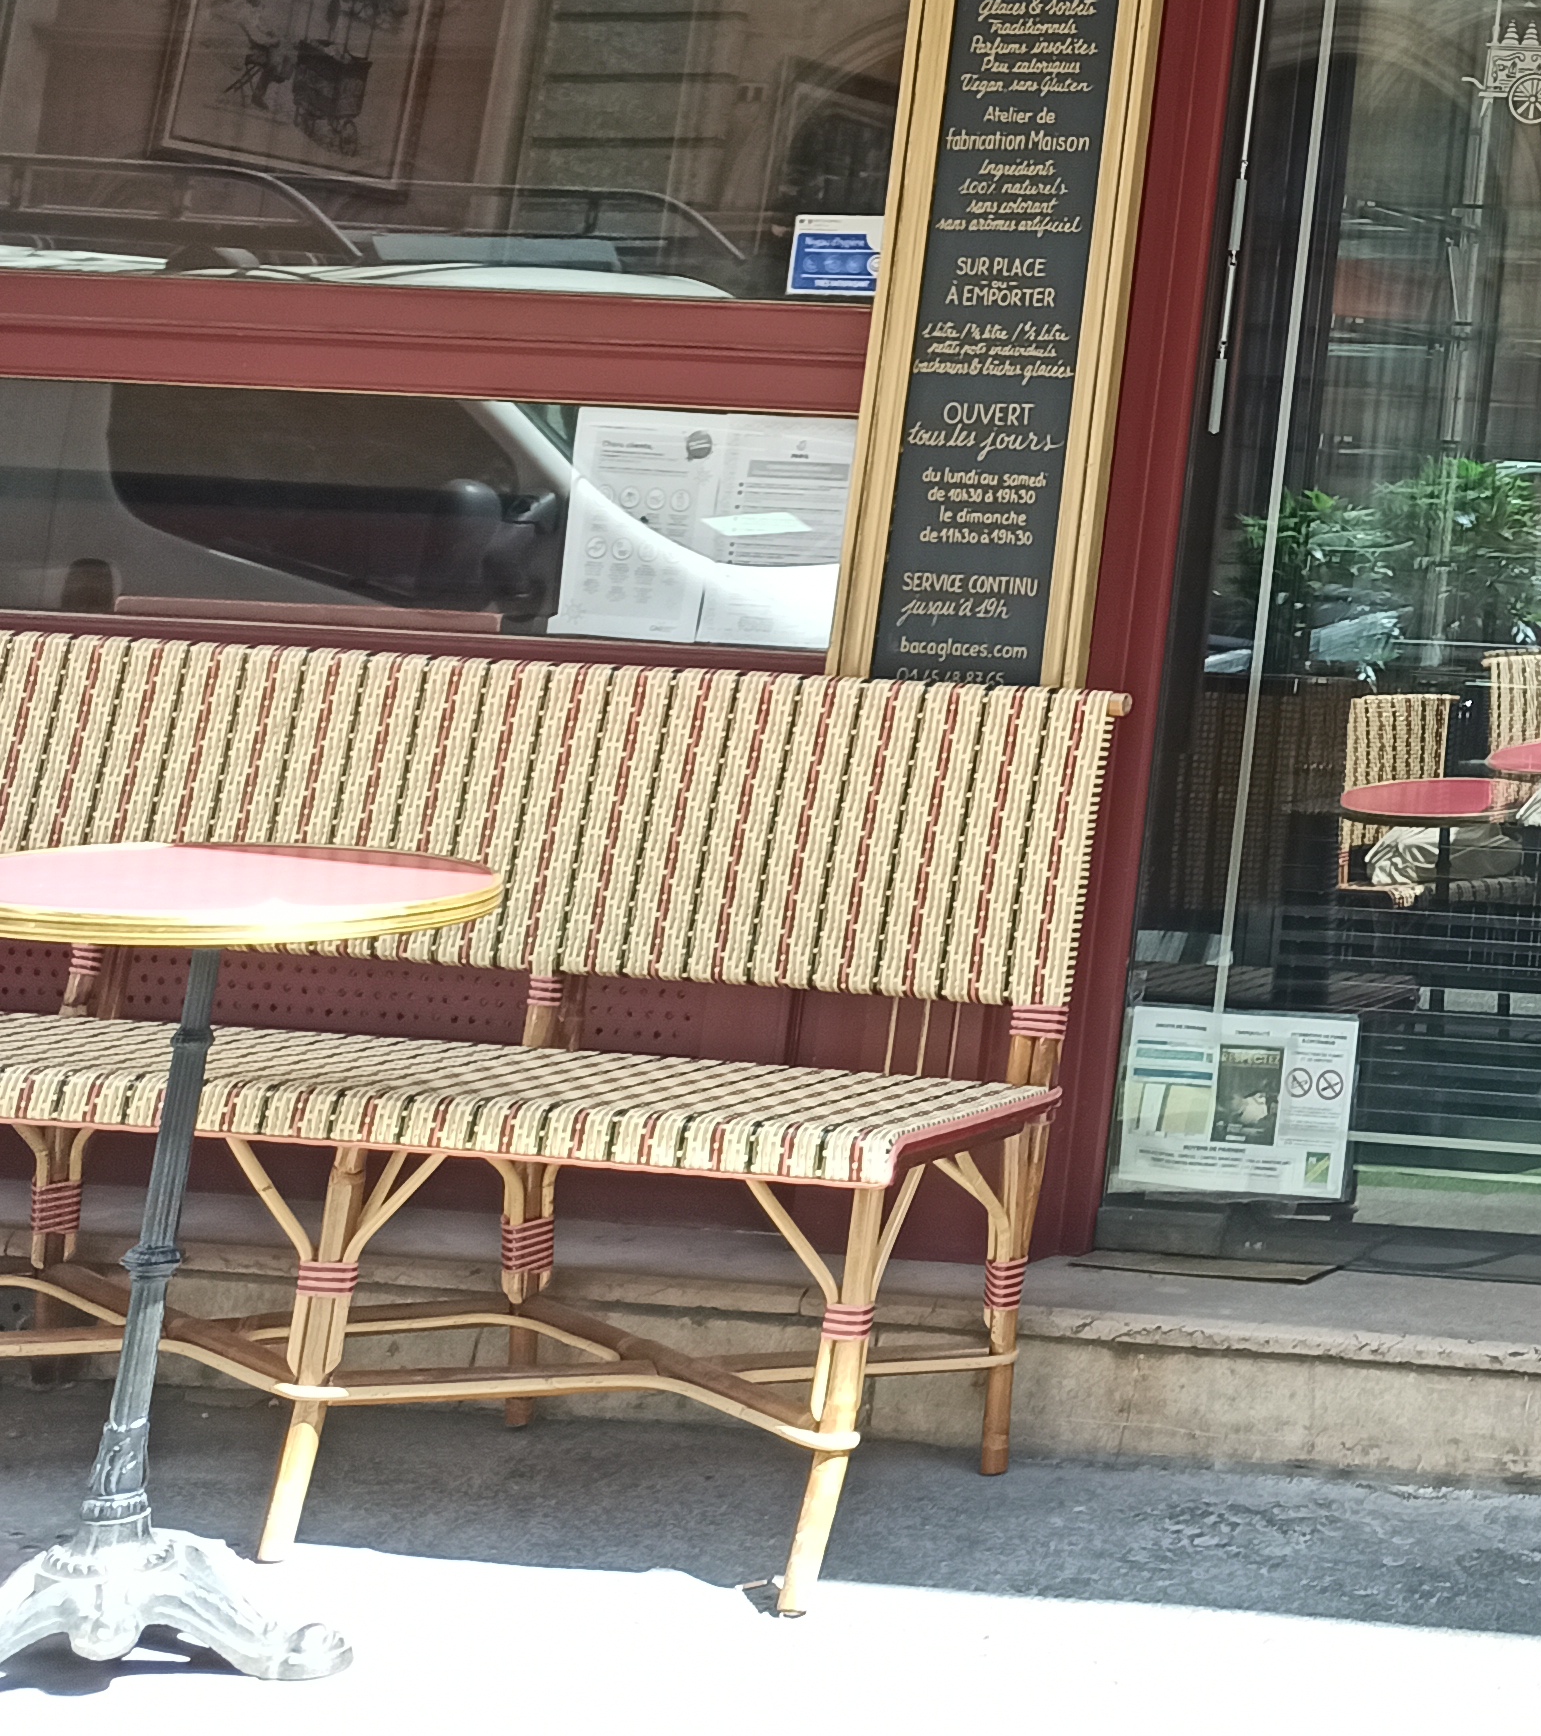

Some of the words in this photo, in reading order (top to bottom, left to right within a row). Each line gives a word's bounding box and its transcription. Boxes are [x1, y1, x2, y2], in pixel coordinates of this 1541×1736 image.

[989, 18, 1078, 35] Traditionnels
[970, 35, 1028, 57] Parfums
[1030, 37, 1098, 55] insolites
[981, 57, 1009, 72] Peu
[1012, 56, 1080, 78] caloriques
[1009, 78, 1039, 92] sans
[983, 106, 1033, 123] Atelier
[1037, 107, 1056, 123] de
[946, 127, 1025, 151] fabrication
[1028, 130, 1090, 152] Maison
[1001, 177, 1068, 194] naturels
[966, 199, 998, 214] sans
[998, 197, 1058, 214] colorant
[935, 217, 966, 231] sans
[956, 257, 989, 276] SUR
[993, 258, 1047, 277] PLACE
[963, 286, 1056, 307] EMPORTER
[943, 402, 1035, 425] OUVERT
[907, 421, 946, 446] tous
[946, 423, 976, 447] les
[977, 427, 1064, 461] jours
[922, 467, 941, 482] du
[944, 467, 980, 484] lundi
[980, 474, 998, 485] au
[1003, 472, 1048, 487] samedi
[928, 486, 945, 501] de
[948, 488, 982, 503] 10h30
[984, 489, 993, 503] à
[996, 489, 1035, 504] 19h30
[939, 505, 952, 522] le
[957, 508, 1027, 525] dimanche
[920, 526, 939, 542] de
[980, 529, 990, 544] à
[990, 529, 1033, 545] 19h30
[902, 572, 965, 592] SERVICE
[968, 575, 1038, 597] CONTINU
[896, 594, 973, 627] jusqu'à
[975, 598, 1010, 619] 19h
[900, 636, 1027, 662] bacaglaces.com
